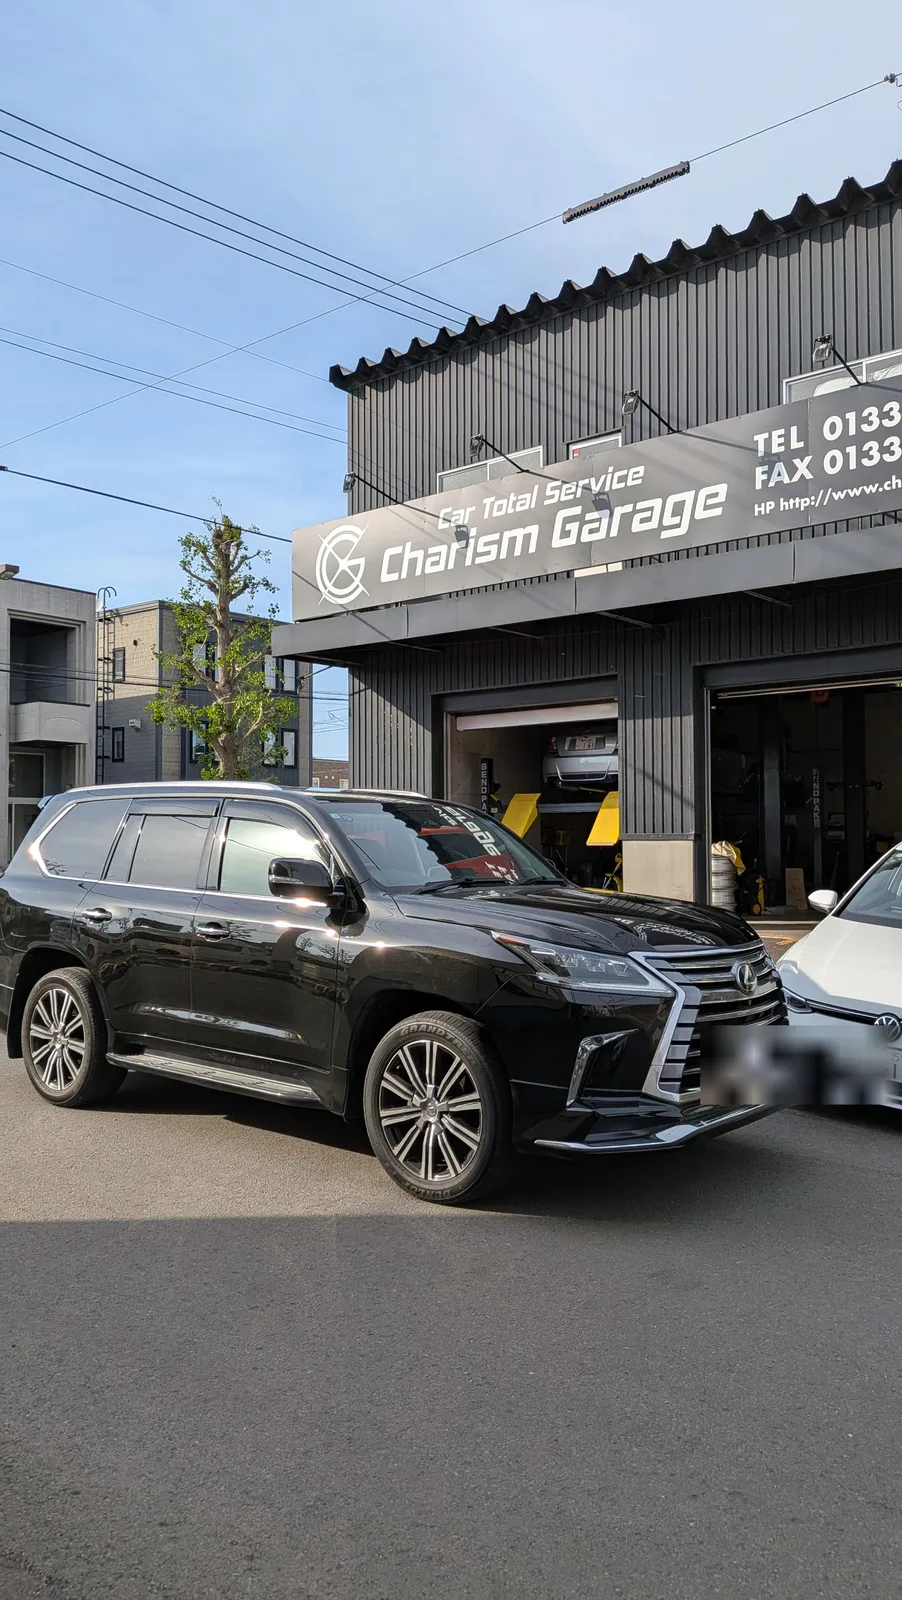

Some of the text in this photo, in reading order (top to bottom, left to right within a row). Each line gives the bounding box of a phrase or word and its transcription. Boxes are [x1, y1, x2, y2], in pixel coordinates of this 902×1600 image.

[753, 401, 902, 458] TEL 0133
[755, 436, 902, 490] FAX 0133
[437, 465, 645, 530] Car Total Service
[754, 500, 775, 516] HP
[380, 483, 728, 583] Charism Garage
